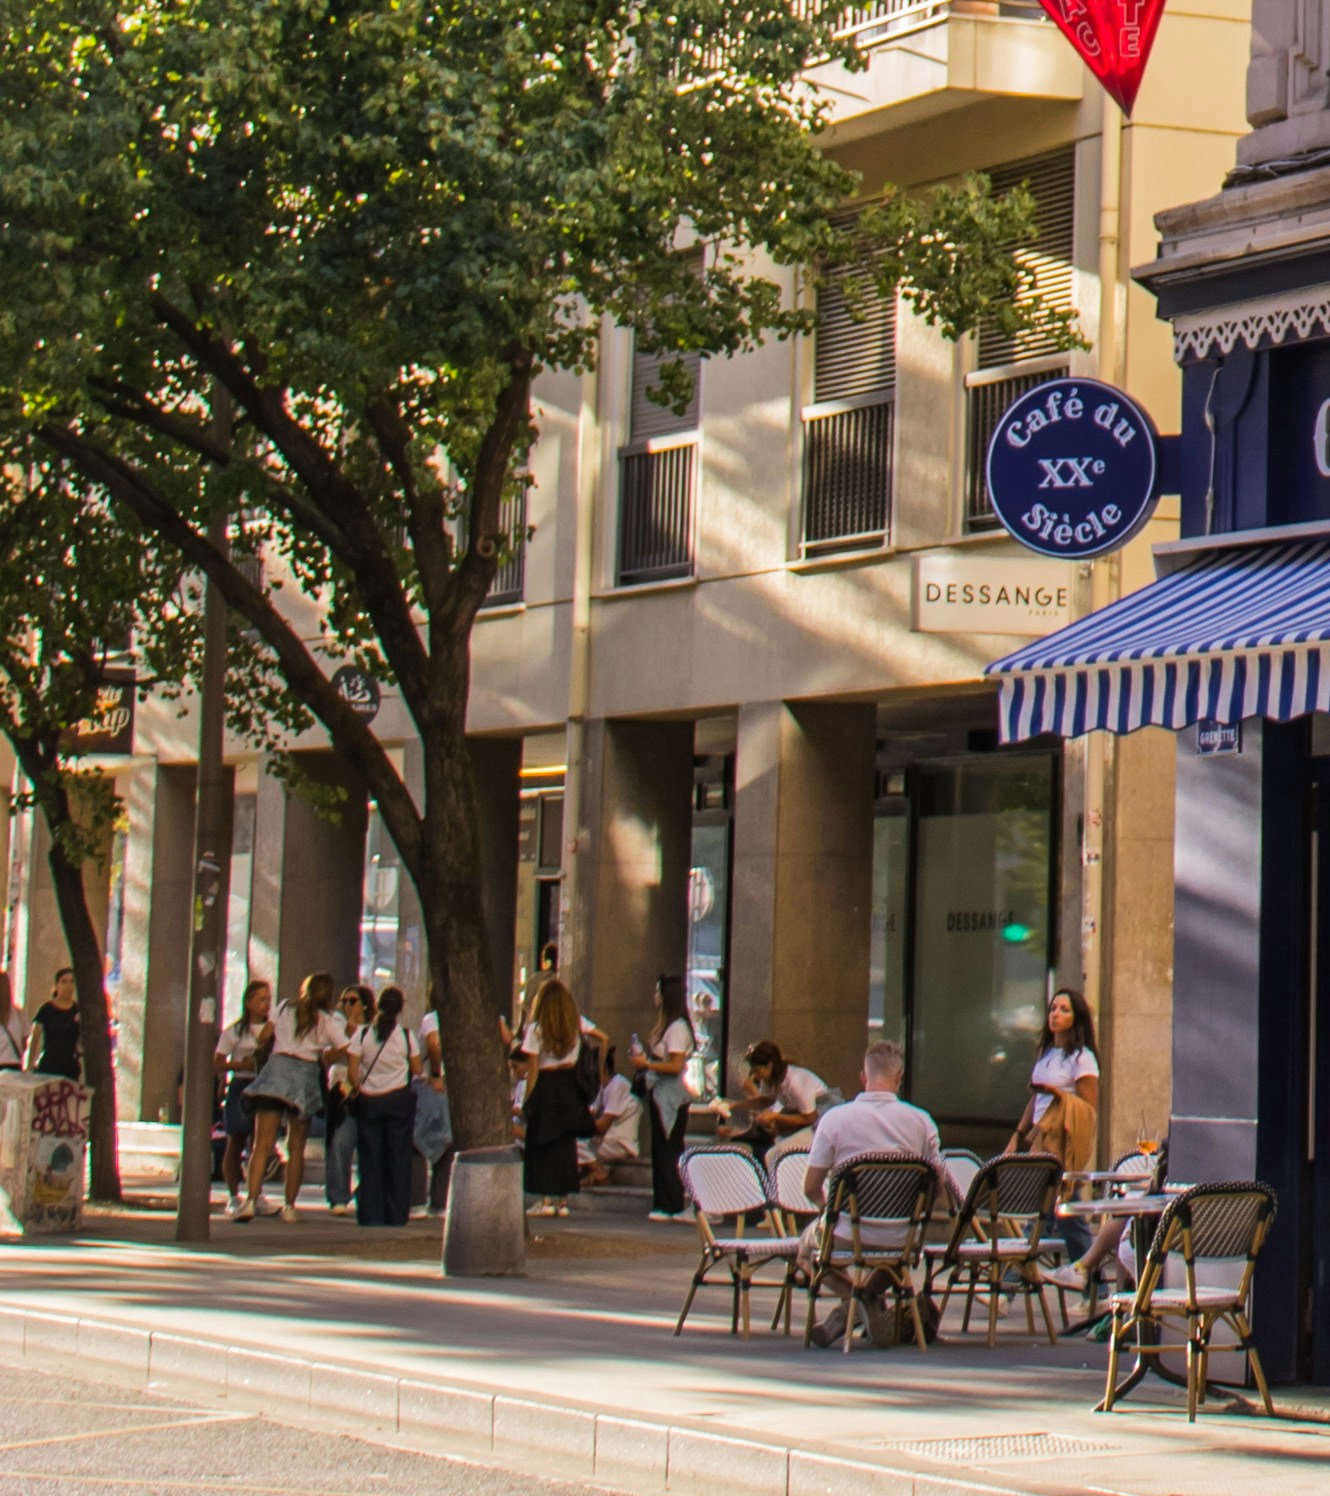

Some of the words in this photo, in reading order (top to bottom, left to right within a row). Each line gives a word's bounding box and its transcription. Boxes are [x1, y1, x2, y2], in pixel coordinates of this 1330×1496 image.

[1006, 387, 1084, 448] Café
[1093, 402, 1137, 449] du
[1038, 457, 1106, 489] XXe
[1021, 503, 1122, 545] Siècle
[926, 582, 1067, 608] DESSANGE
[1028, 609, 1059, 617] PARIS
[946, 910, 1015, 932] DESSANE
